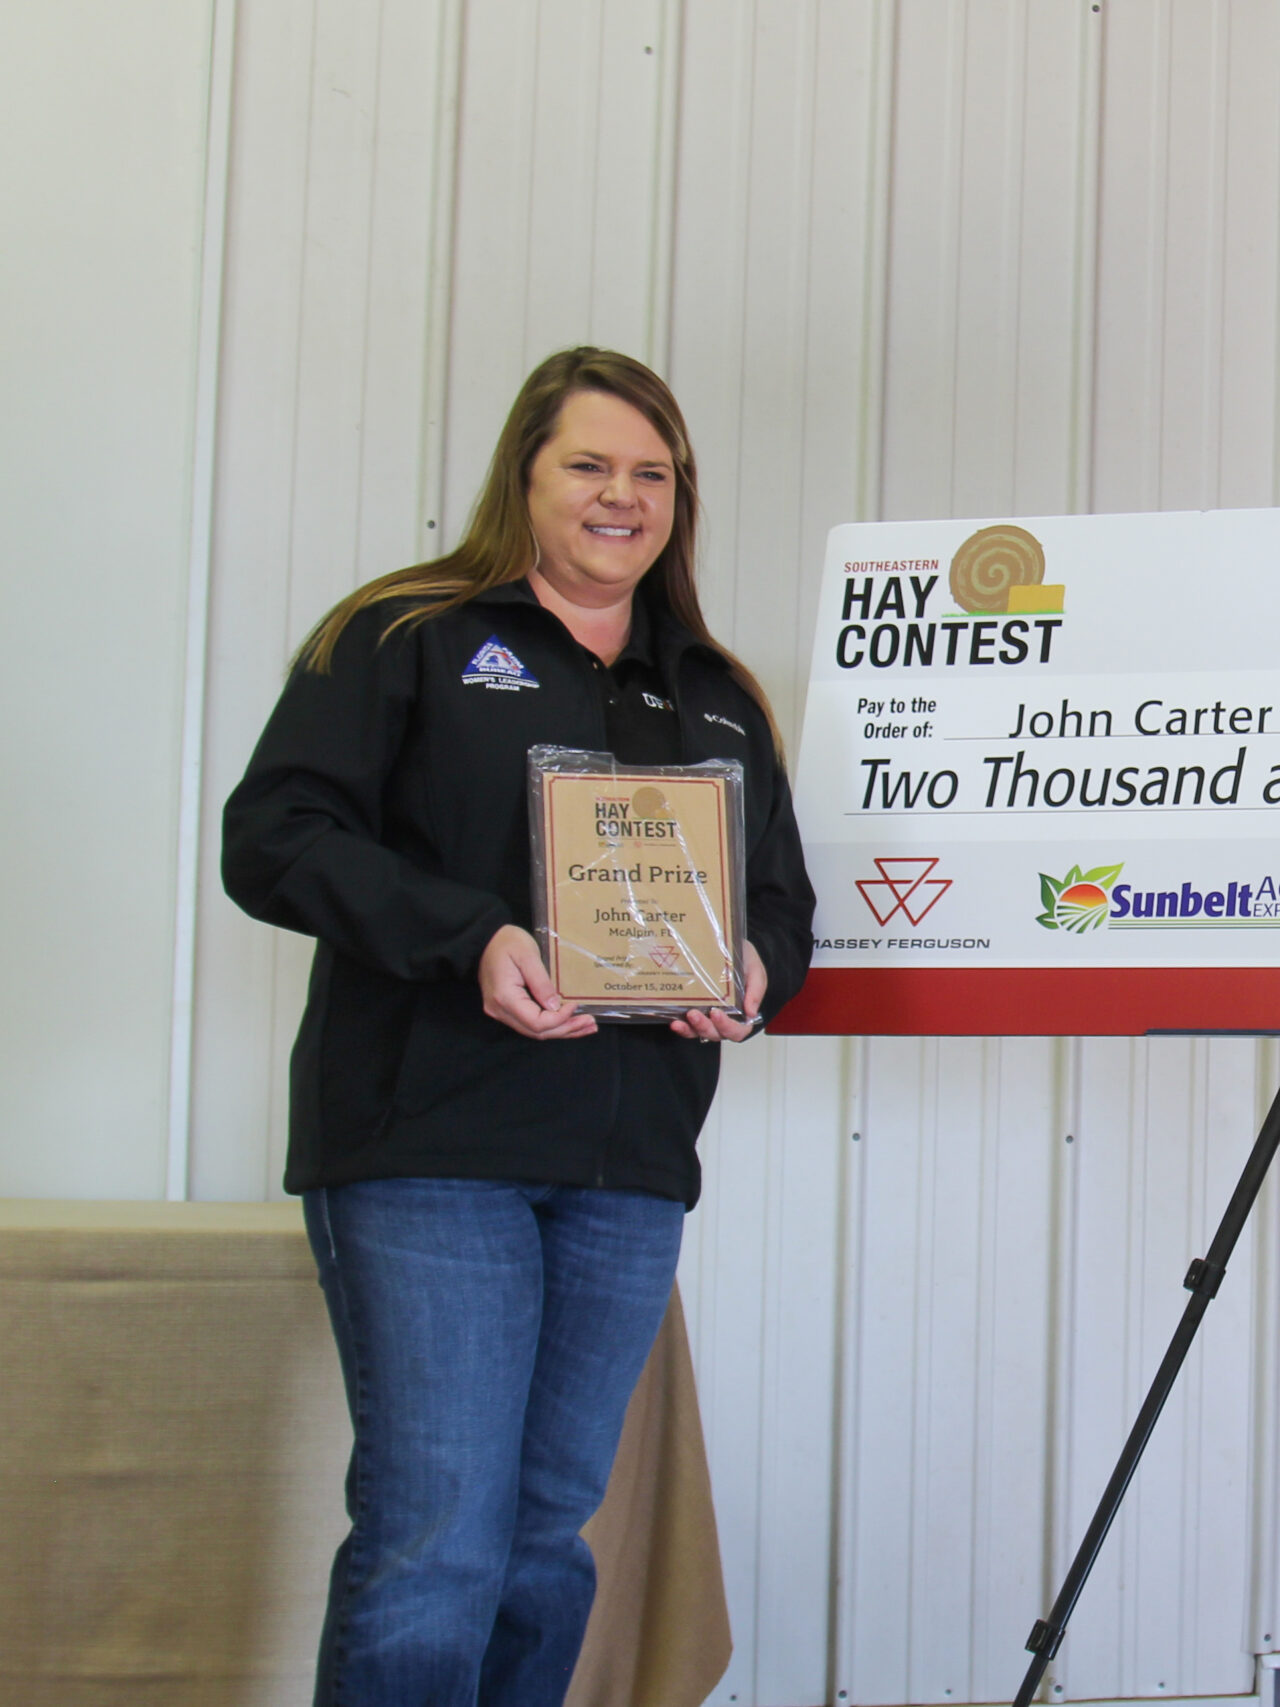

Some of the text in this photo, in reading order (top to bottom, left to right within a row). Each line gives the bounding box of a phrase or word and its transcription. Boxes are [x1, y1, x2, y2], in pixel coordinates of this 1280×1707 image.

[844, 560, 939, 573] SOUTHEASTERN
[841, 575, 939, 621] HAY
[836, 619, 1062, 669] CONTEST
[857, 696, 937, 718] Pay to the
[1008, 699, 1273, 739] John Carter
[863, 720, 933, 739] Order of:
[860, 758, 959, 810] Two
[982, 746, 1248, 809] Thousand
[595, 803, 629, 819] HAY
[596, 820, 677, 838] CONTEST
[569, 864, 708, 884] Grand Prize
[1110, 881, 1253, 918] Sunbelt
[594, 907, 631, 924] John
[887, 938, 990, 949] FERGUSON
[604, 982, 684, 993] October 15, 2024
